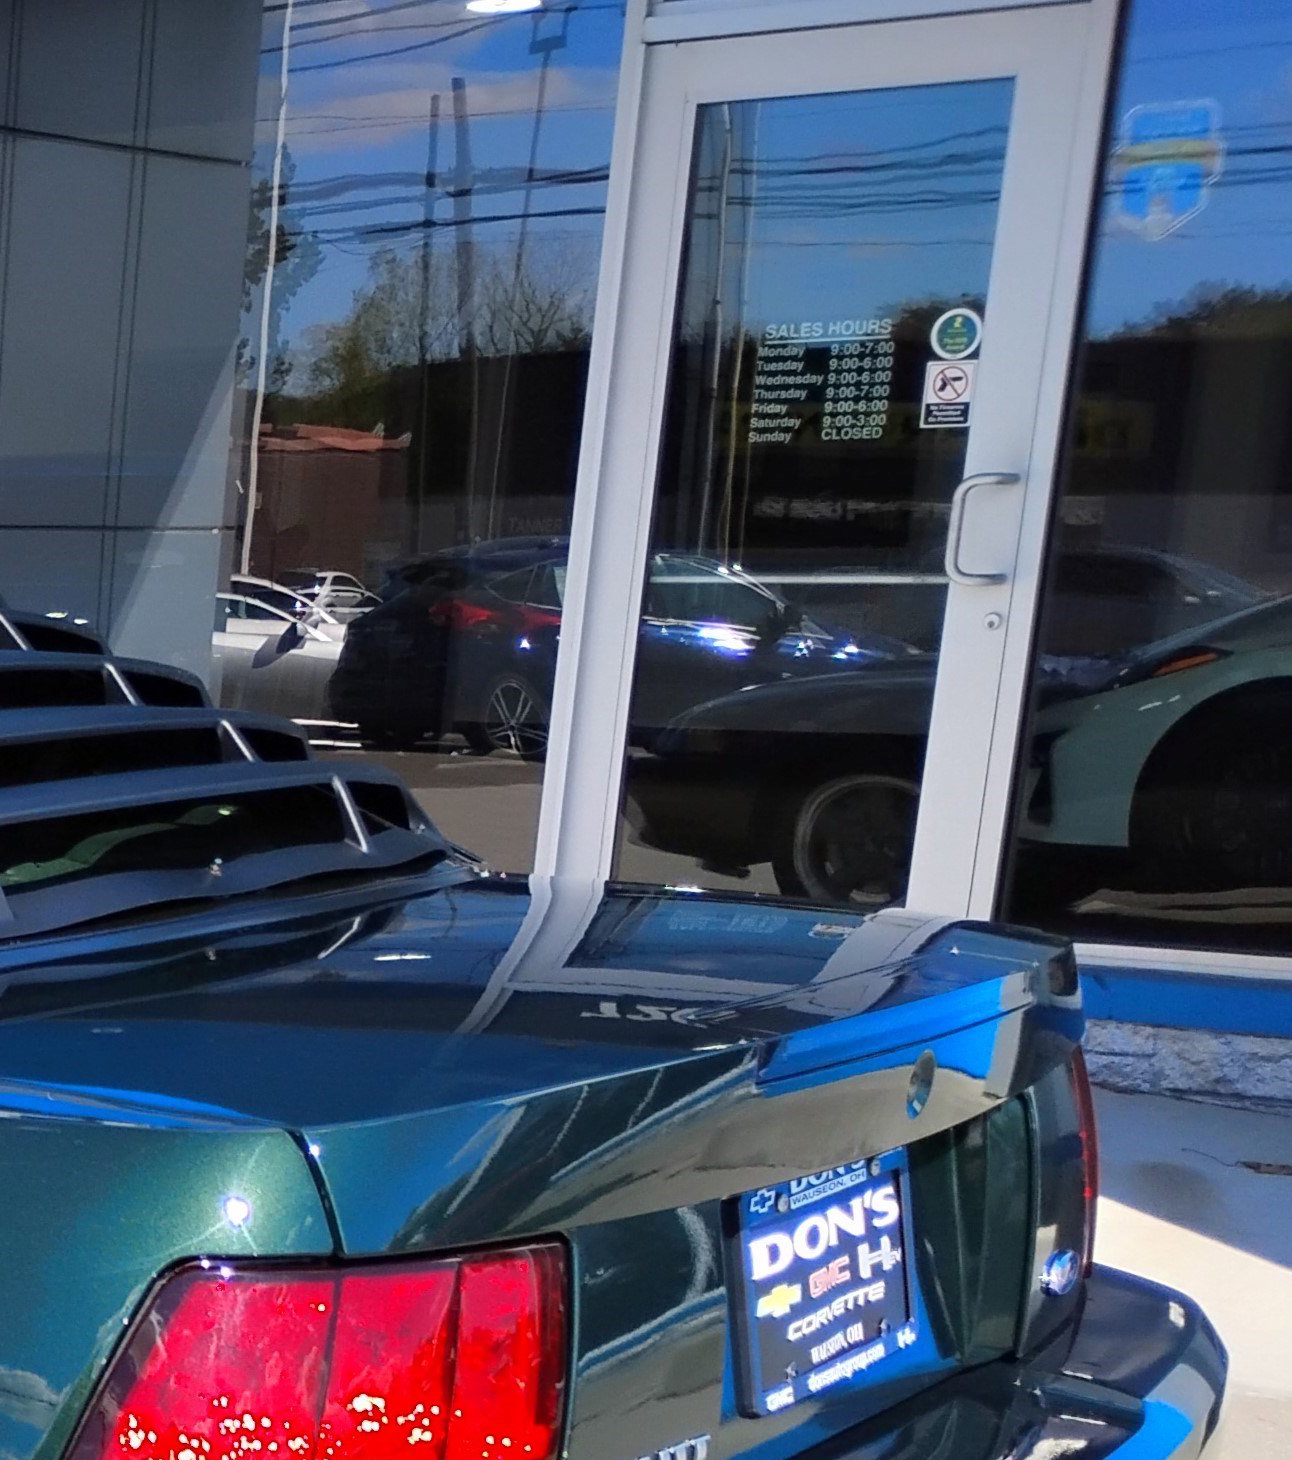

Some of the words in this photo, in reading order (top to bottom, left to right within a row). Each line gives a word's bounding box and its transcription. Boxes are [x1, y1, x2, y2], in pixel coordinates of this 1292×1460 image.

[765, 322, 823, 339] SALES
[828, 319, 893, 335] HOURS
[757, 345, 806, 358] Monday
[756, 360, 804, 372] Tuesday
[755, 373, 824, 385] Wednesday
[753, 388, 808, 400] Thursday
[751, 402, 788, 415] Friday
[750, 417, 801, 429] Saturday
[748, 431, 792, 444] Sunday
[821, 427, 883, 440] CLOSED
[749, 1185, 900, 1280] DON'S
[809, 1254, 851, 1298] GMC
[787, 1280, 886, 1342] CORVETTE
